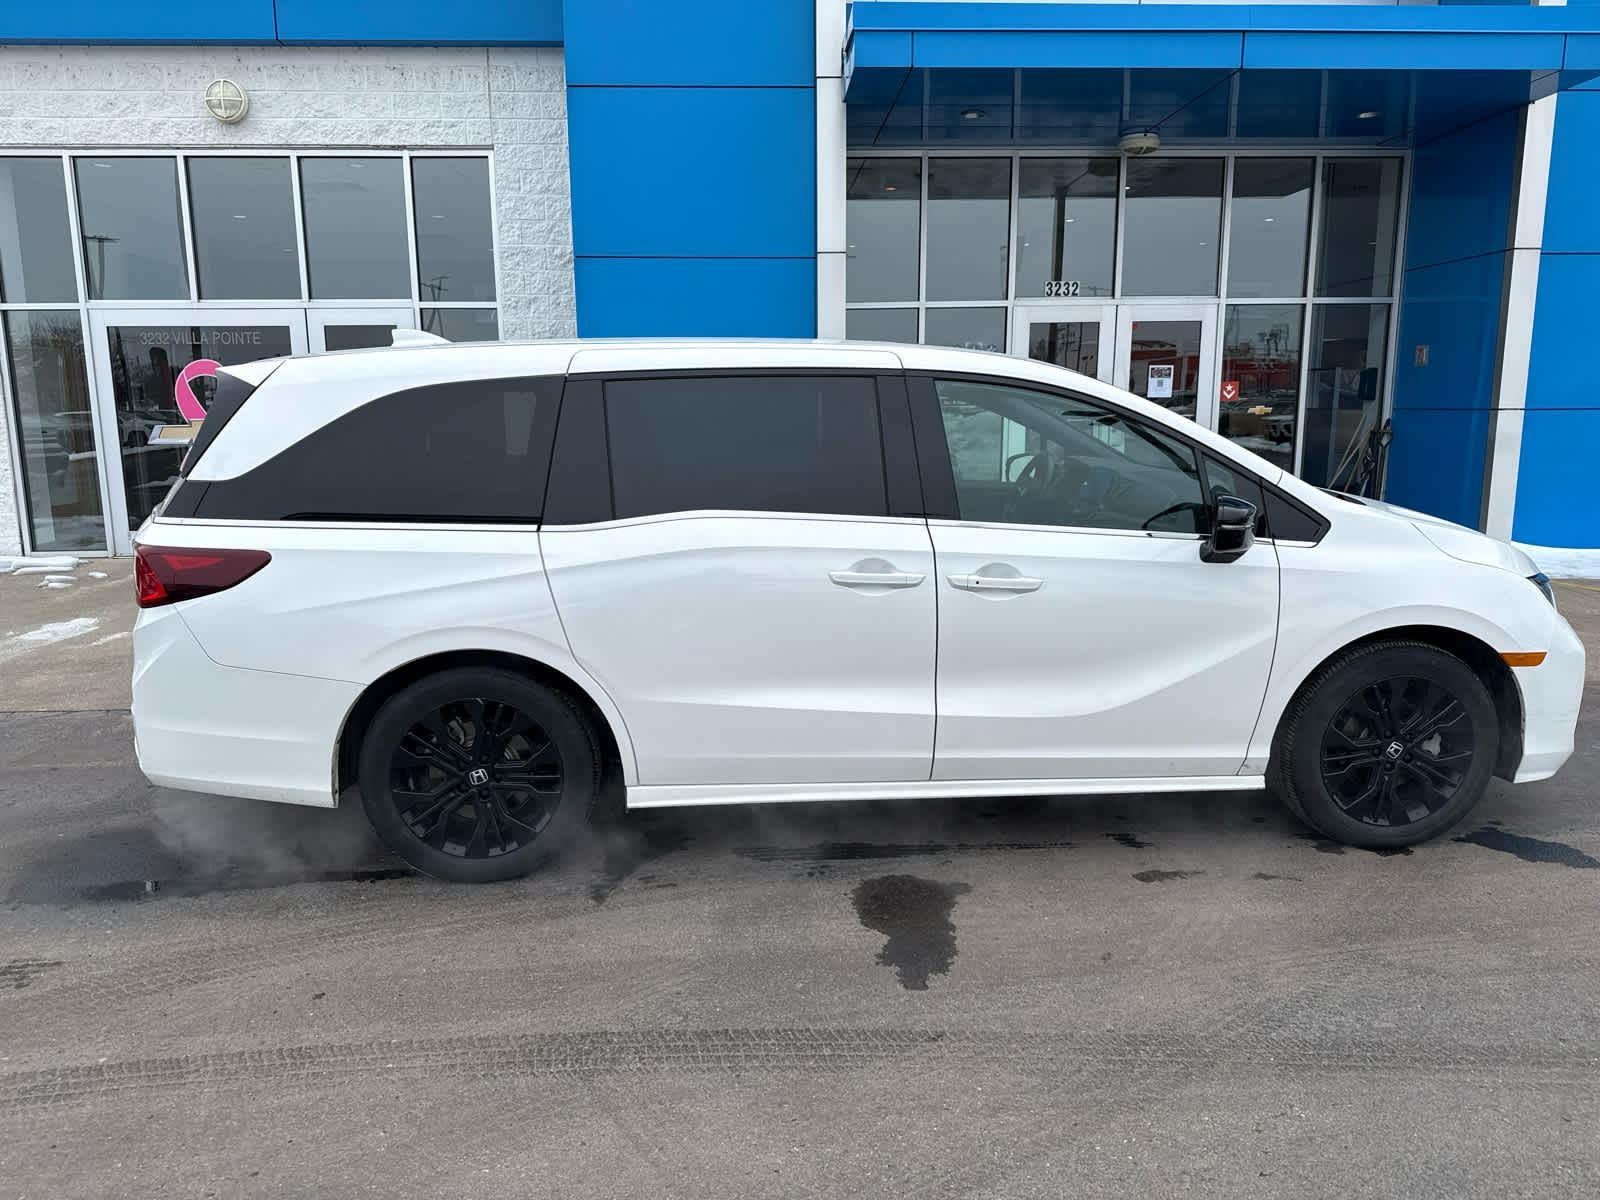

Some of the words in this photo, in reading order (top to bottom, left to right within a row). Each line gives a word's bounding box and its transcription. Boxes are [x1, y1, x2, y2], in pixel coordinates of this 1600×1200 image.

[1046, 281, 1079, 297] 3232
[139, 331, 170, 345] 3232
[173, 331, 209, 345] VILLA
[212, 331, 262, 345] POINTE
